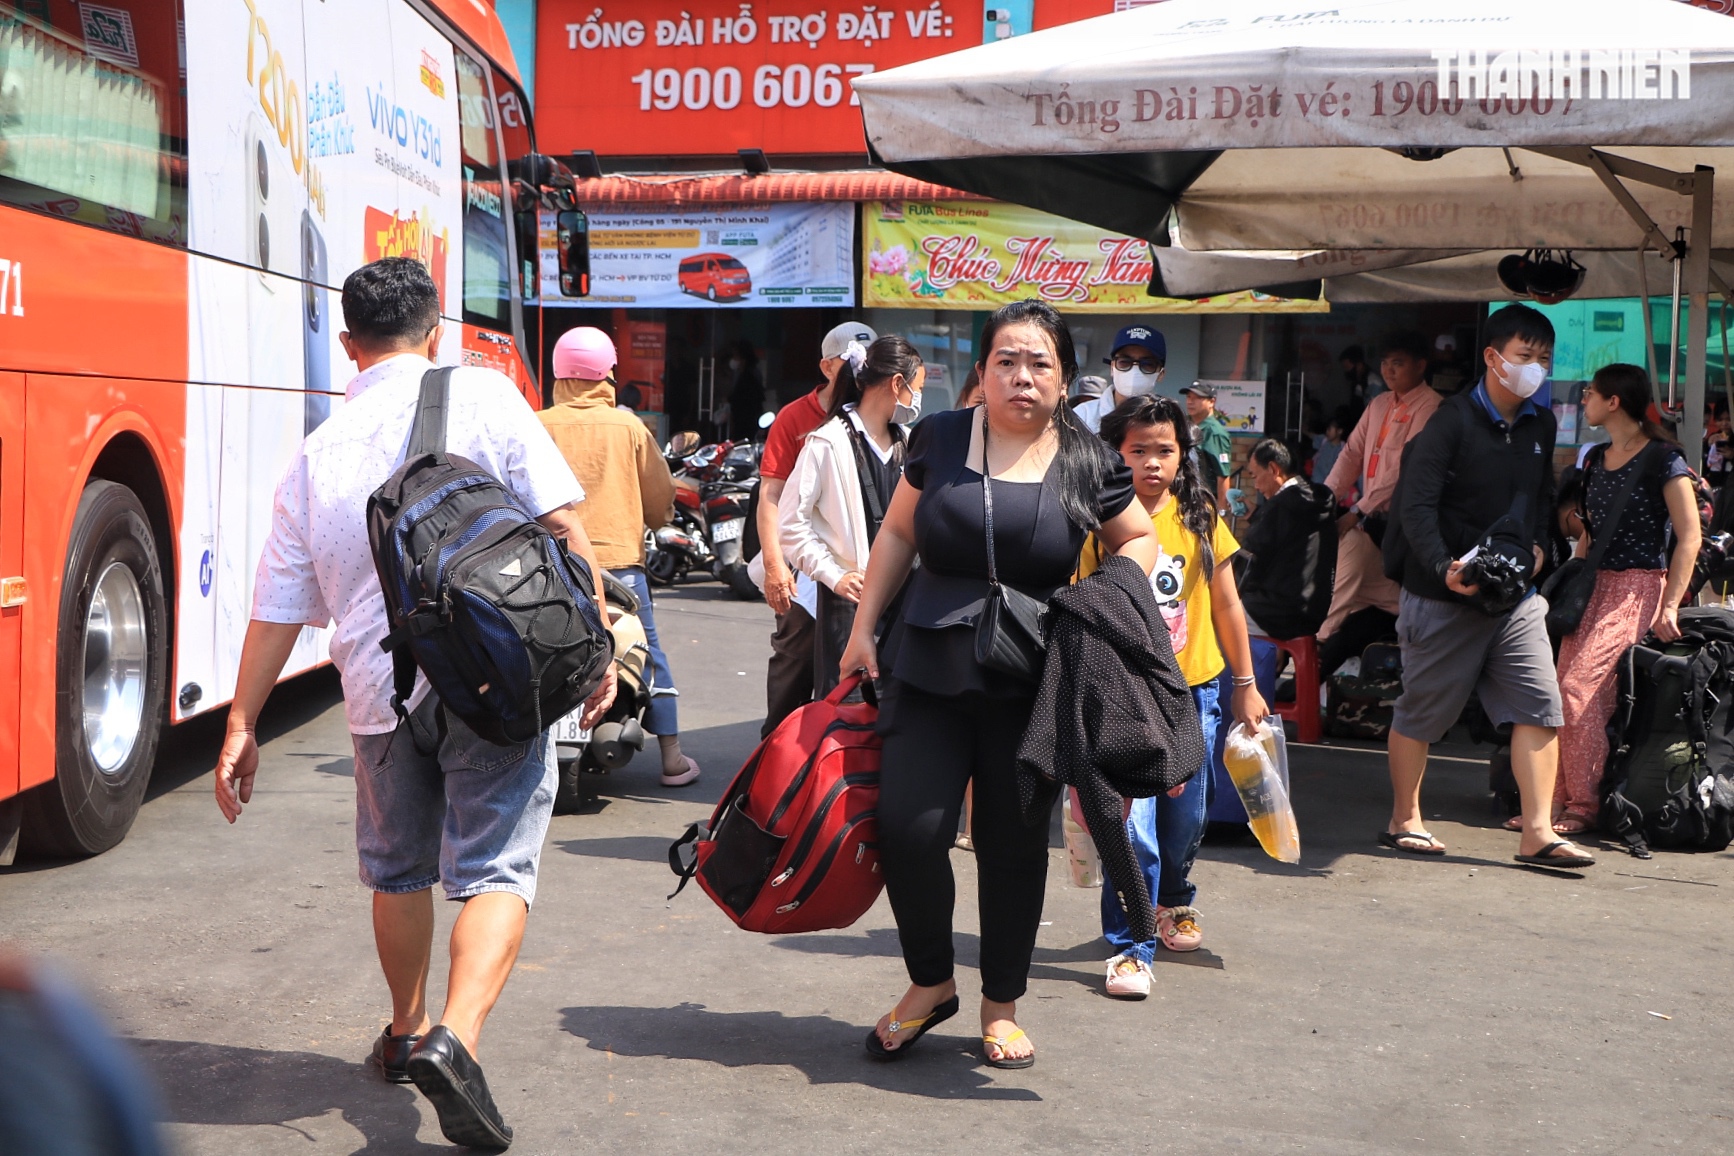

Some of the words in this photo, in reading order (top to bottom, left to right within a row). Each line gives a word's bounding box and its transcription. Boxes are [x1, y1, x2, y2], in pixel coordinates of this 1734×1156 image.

[566, 8, 645, 49] TỔNG
[655, 11, 704, 46] ĐÀI
[712, 3, 757, 44] HỖ
[768, 11, 827, 48] TRỢ
[836, 5, 894, 47] ĐẶT
[906, 1, 953, 37] VÉ:
[1250, 9, 1340, 24] FUTA
[631, 66, 742, 111] 1900
[1027, 82, 1120, 133] Tổng
[1132, 86, 1198, 122] Đài
[1211, 84, 1282, 128] Đặt
[1294, 81, 1352, 117] vé:
[1370, 80, 1464, 117] 1900
[366, 80, 408, 148] vivo
[409, 109, 442, 169] Y31d
[908, 205, 934, 216] FUTA
[936, 206, 957, 217] Bus
[958, 207, 989, 217] Lines
[922, 235, 999, 289] Chúc
[989, 236, 1089, 300] Mừng
[1089, 237, 1153, 285] Năm
